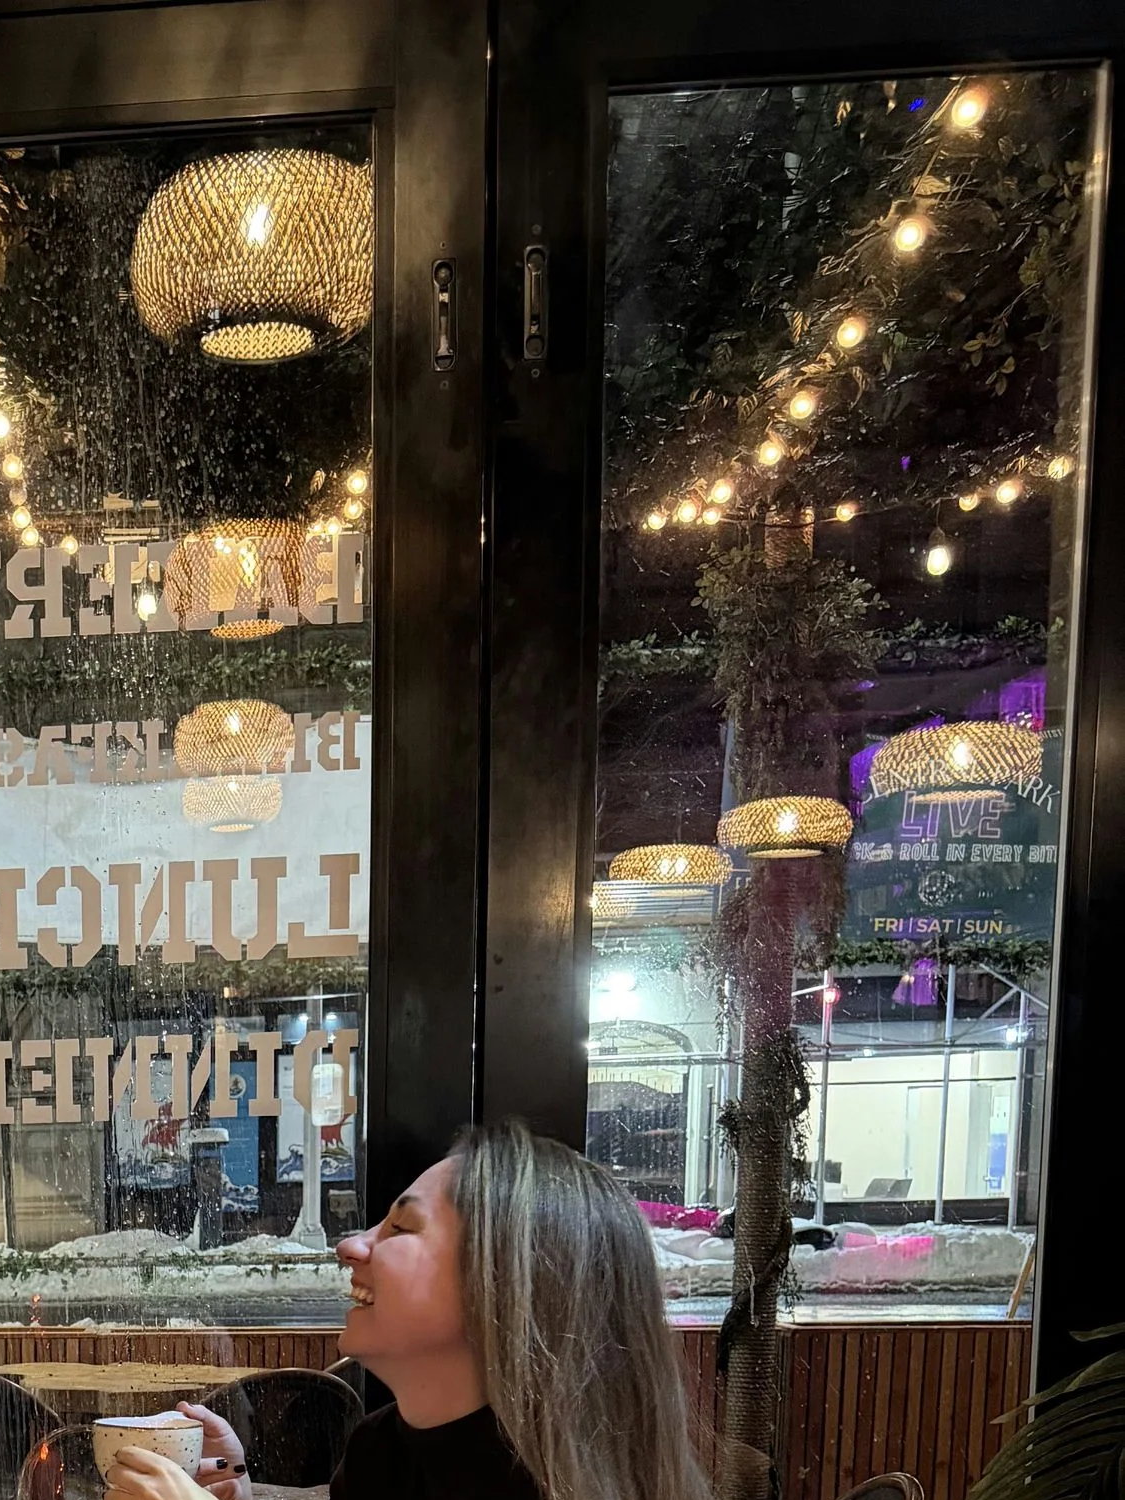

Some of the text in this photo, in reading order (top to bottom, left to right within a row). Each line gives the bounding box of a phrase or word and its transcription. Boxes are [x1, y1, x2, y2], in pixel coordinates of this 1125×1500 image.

[900, 787, 1007, 838] LIVE
[899, 842, 940, 861] ROLL
[946, 843, 966, 862] IN
[970, 843, 1023, 863] EVERY
[1028, 845, 1057, 863] BIT
[874, 917, 1003, 934] FRI SAT SUN
